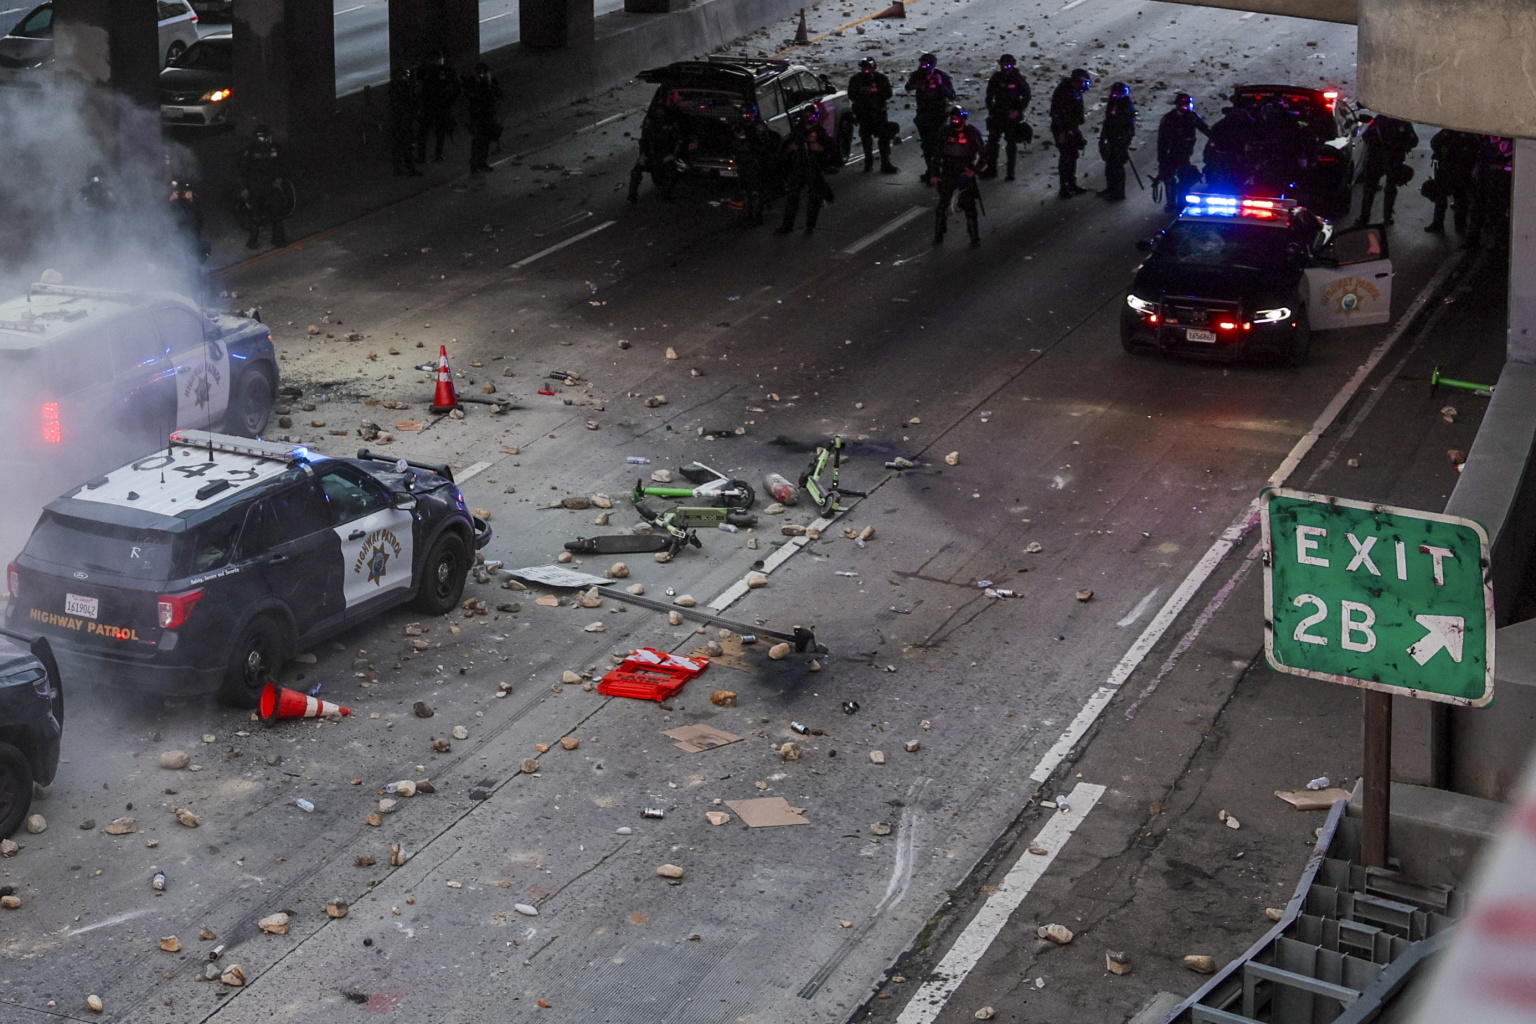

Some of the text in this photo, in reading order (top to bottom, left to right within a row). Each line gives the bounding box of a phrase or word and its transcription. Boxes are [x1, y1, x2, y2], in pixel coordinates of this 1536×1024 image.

[354, 529, 402, 573] HIGHWAY PATROL
[1296, 525, 1454, 586] EXIT
[30, 608, 139, 640] HIGHWAY PATROL
[1293, 593, 1377, 652] 2B
